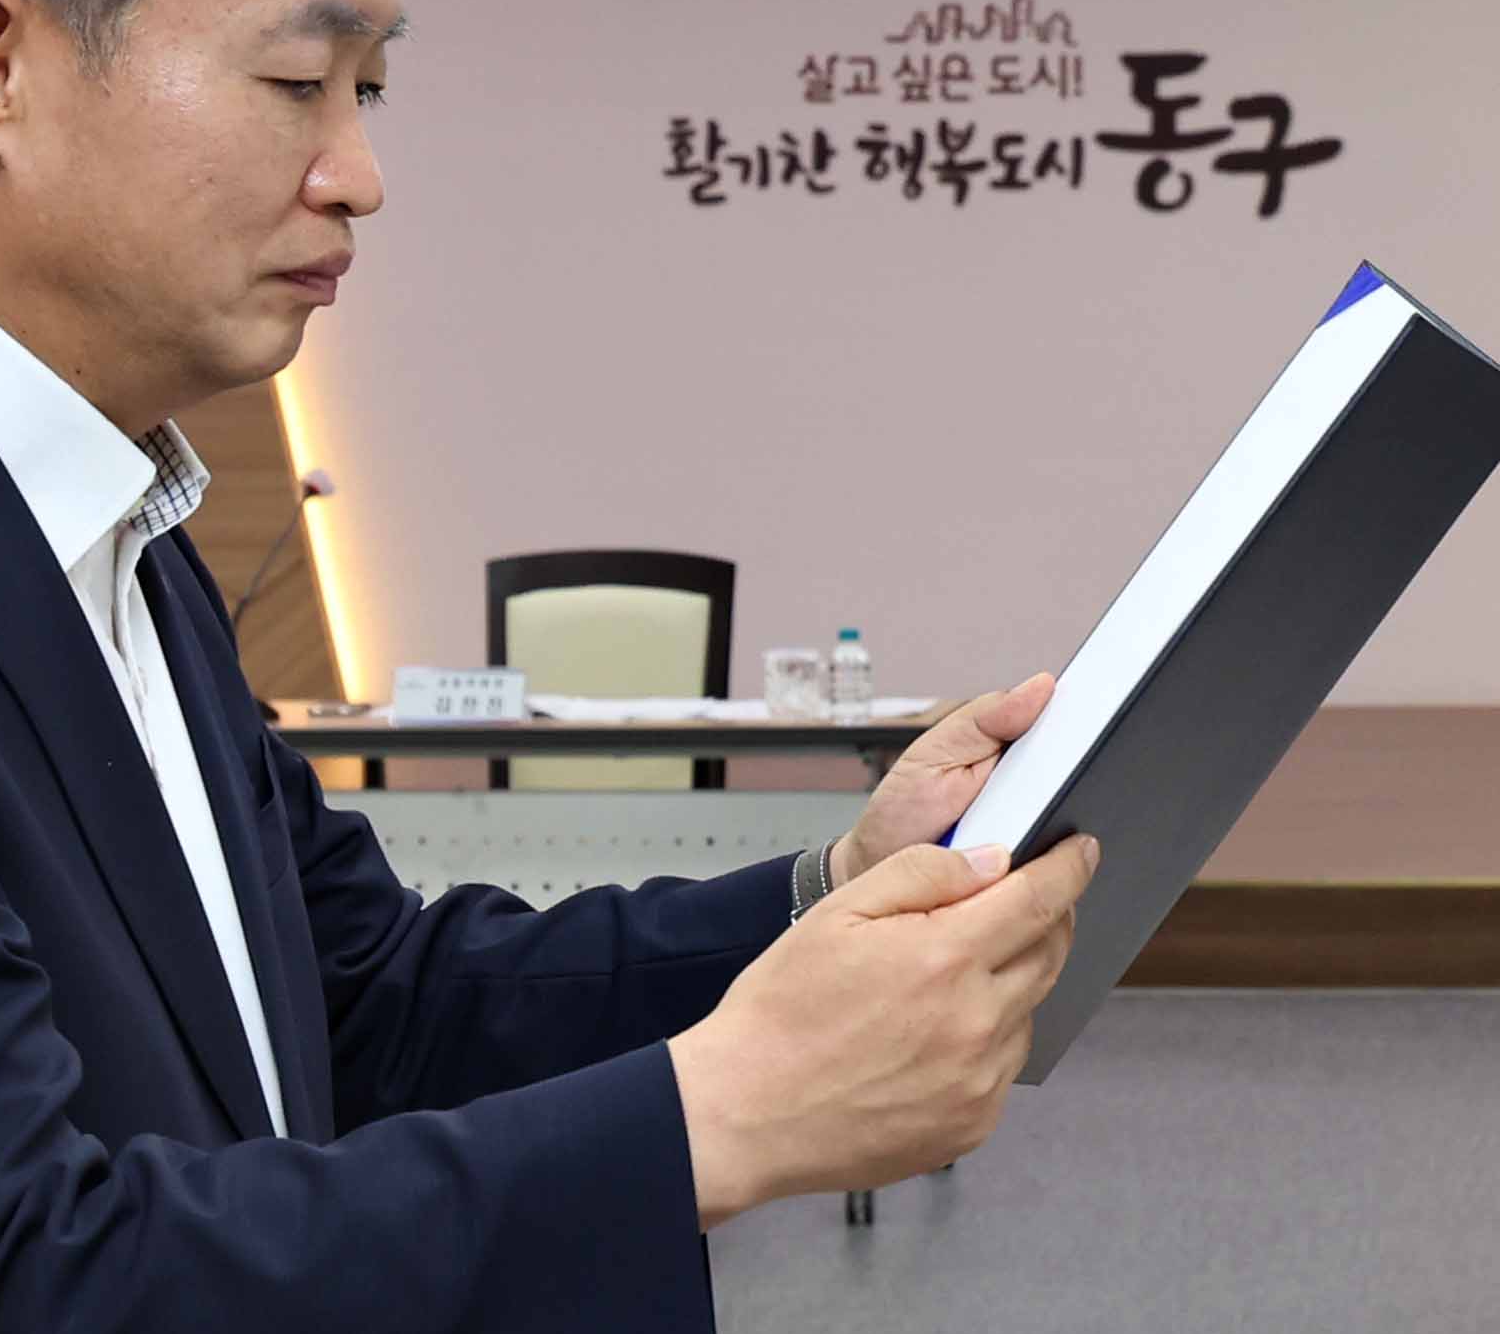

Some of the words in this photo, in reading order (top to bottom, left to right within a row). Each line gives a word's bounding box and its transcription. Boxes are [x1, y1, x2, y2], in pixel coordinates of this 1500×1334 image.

[799, 54, 880, 102] 살고
[893, 54, 974, 102] 싶은
[988, 54, 1085, 99] 도시!
[662, 118, 839, 206] 활기찬
[1095, 52, 1343, 219] 동구
